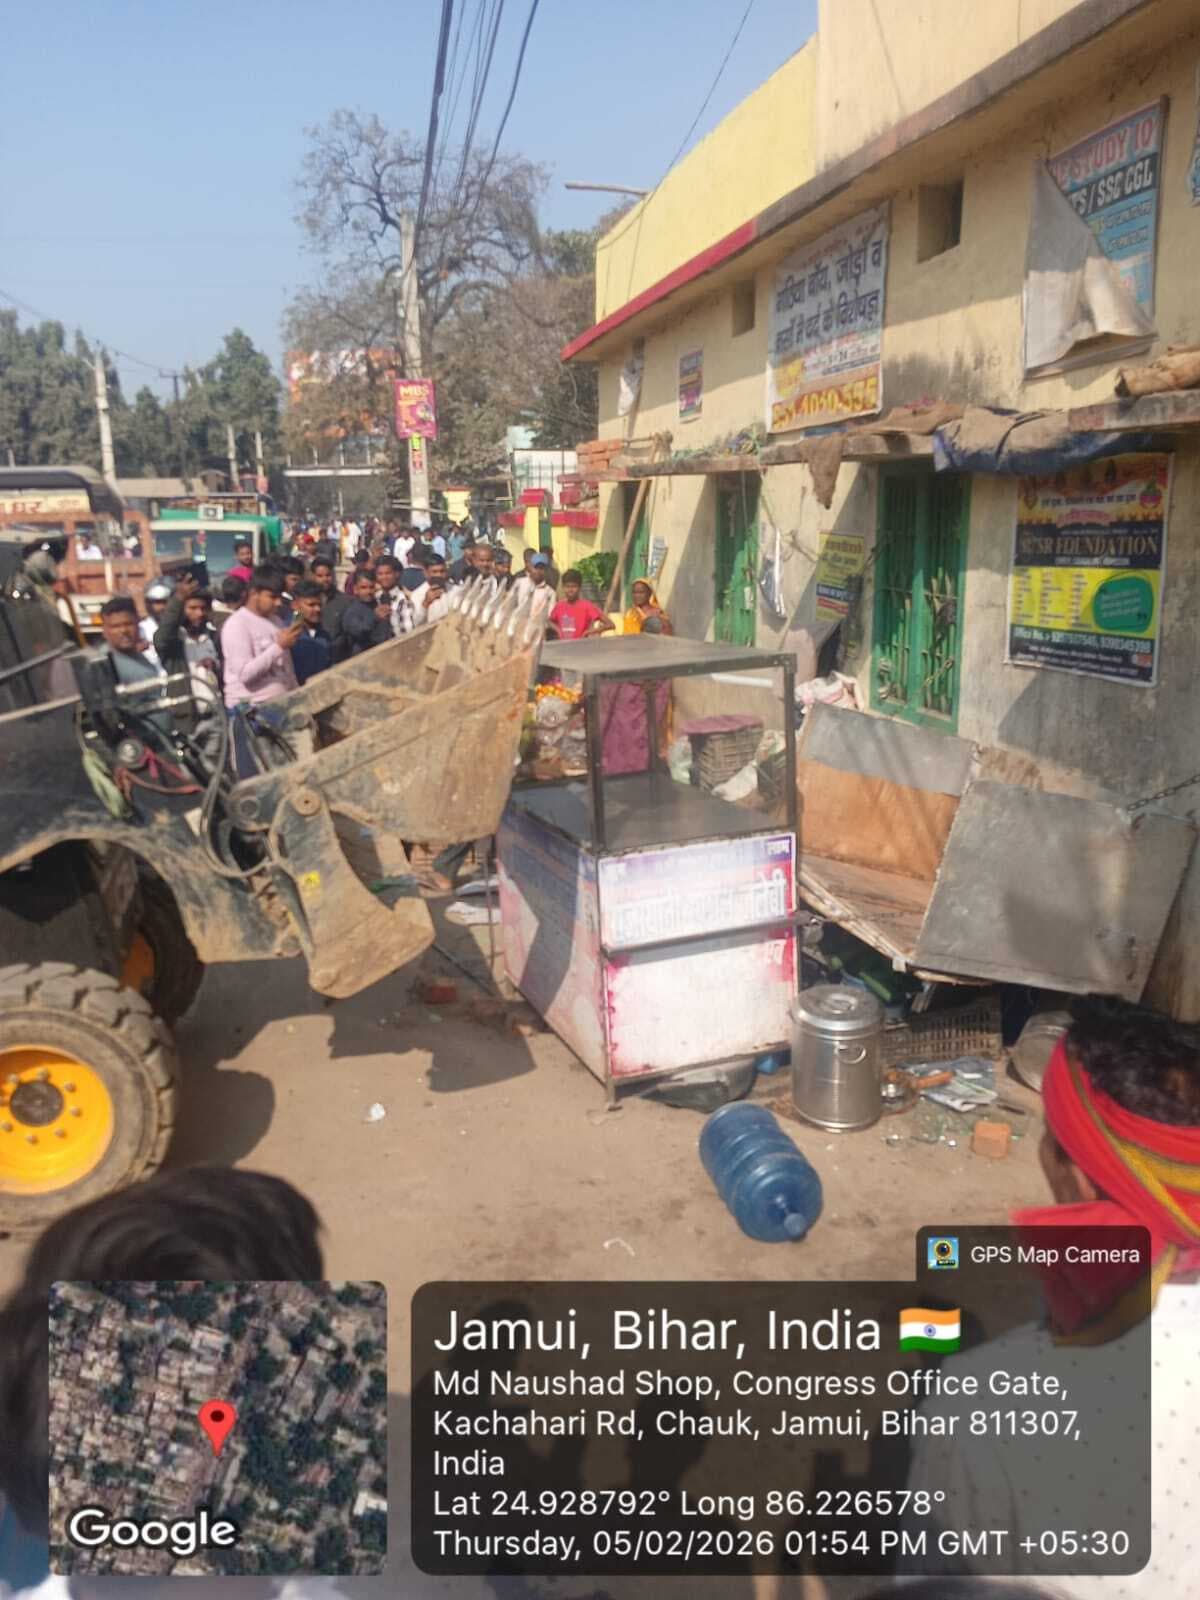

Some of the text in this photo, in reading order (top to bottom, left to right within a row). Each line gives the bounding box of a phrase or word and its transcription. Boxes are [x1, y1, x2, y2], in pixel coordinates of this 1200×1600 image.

[1097, 174, 1124, 206] SSC
[1125, 159, 1153, 193] CGL
[1055, 534, 1159, 556] FOUNDATION
